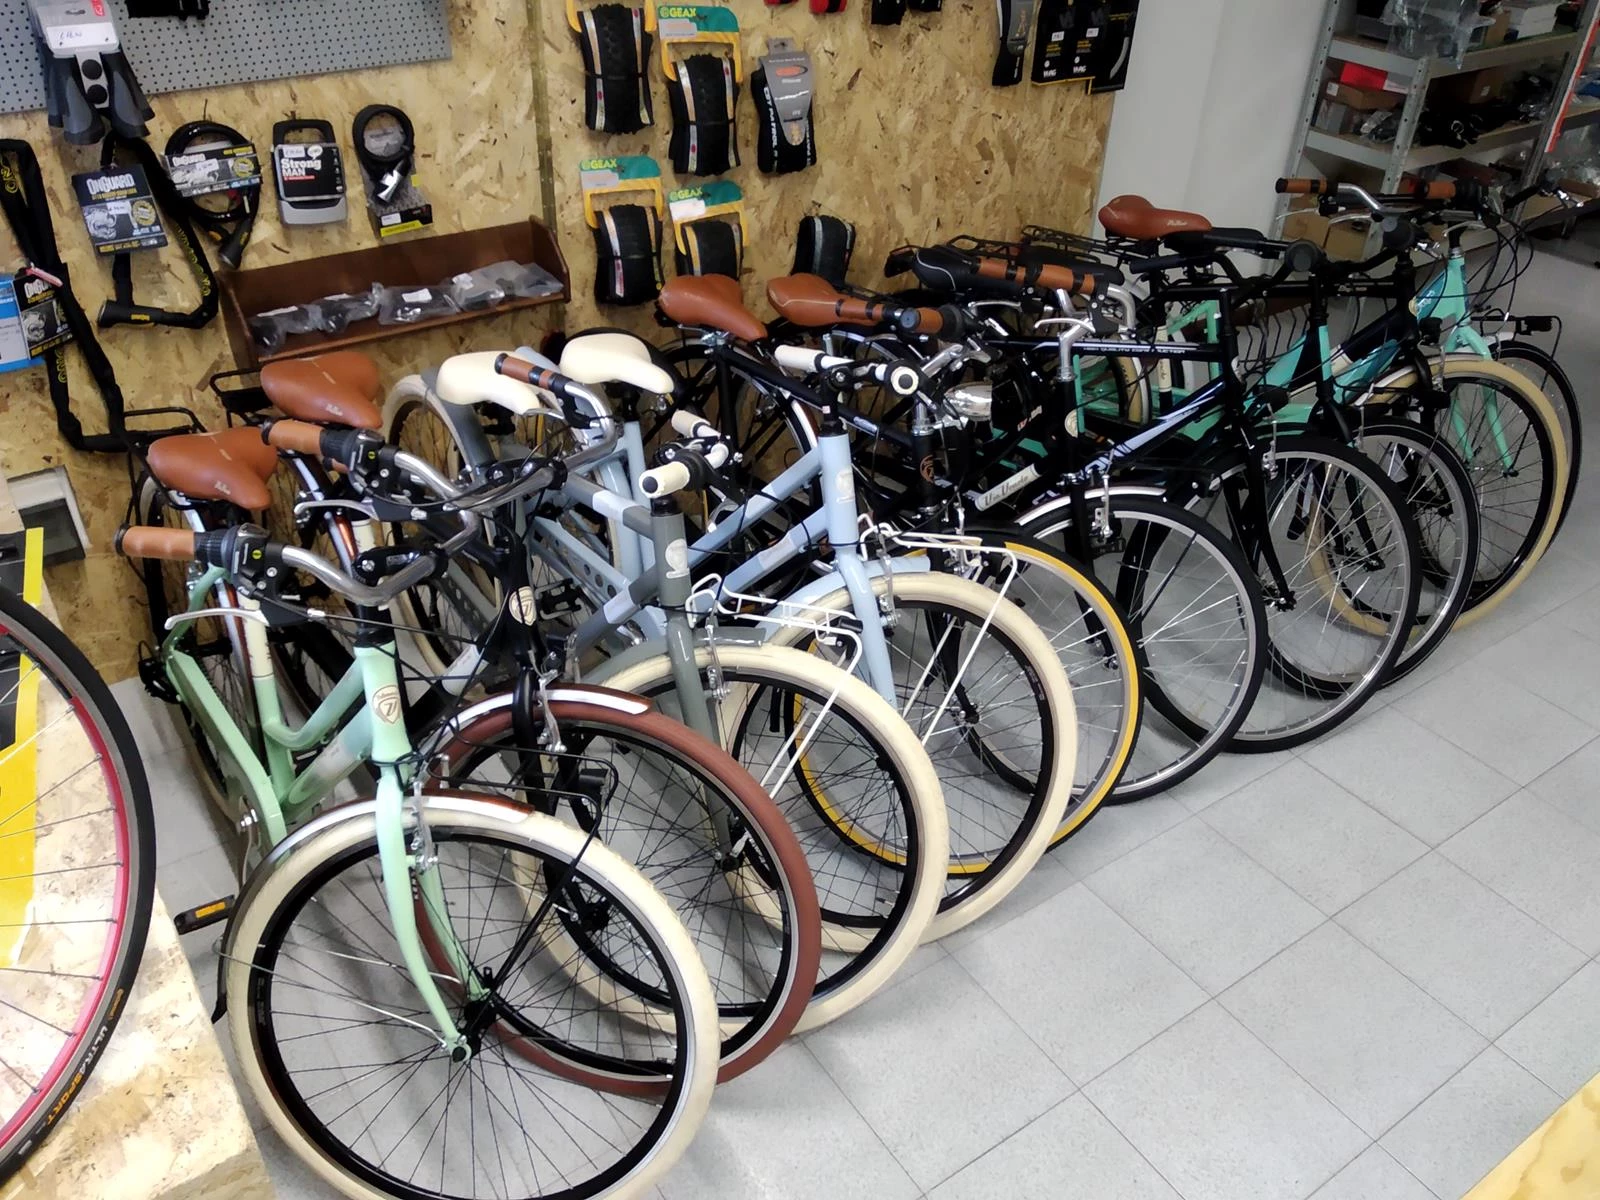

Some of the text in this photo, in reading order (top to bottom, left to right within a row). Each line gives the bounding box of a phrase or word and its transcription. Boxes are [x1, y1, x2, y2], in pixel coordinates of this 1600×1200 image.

[669, 7, 697, 18] GEAX
[280, 157, 322, 171] Strong
[590, 159, 618, 170] GEAX
[282, 168, 306, 177] MAN
[677, 186, 704, 200] GEAX
